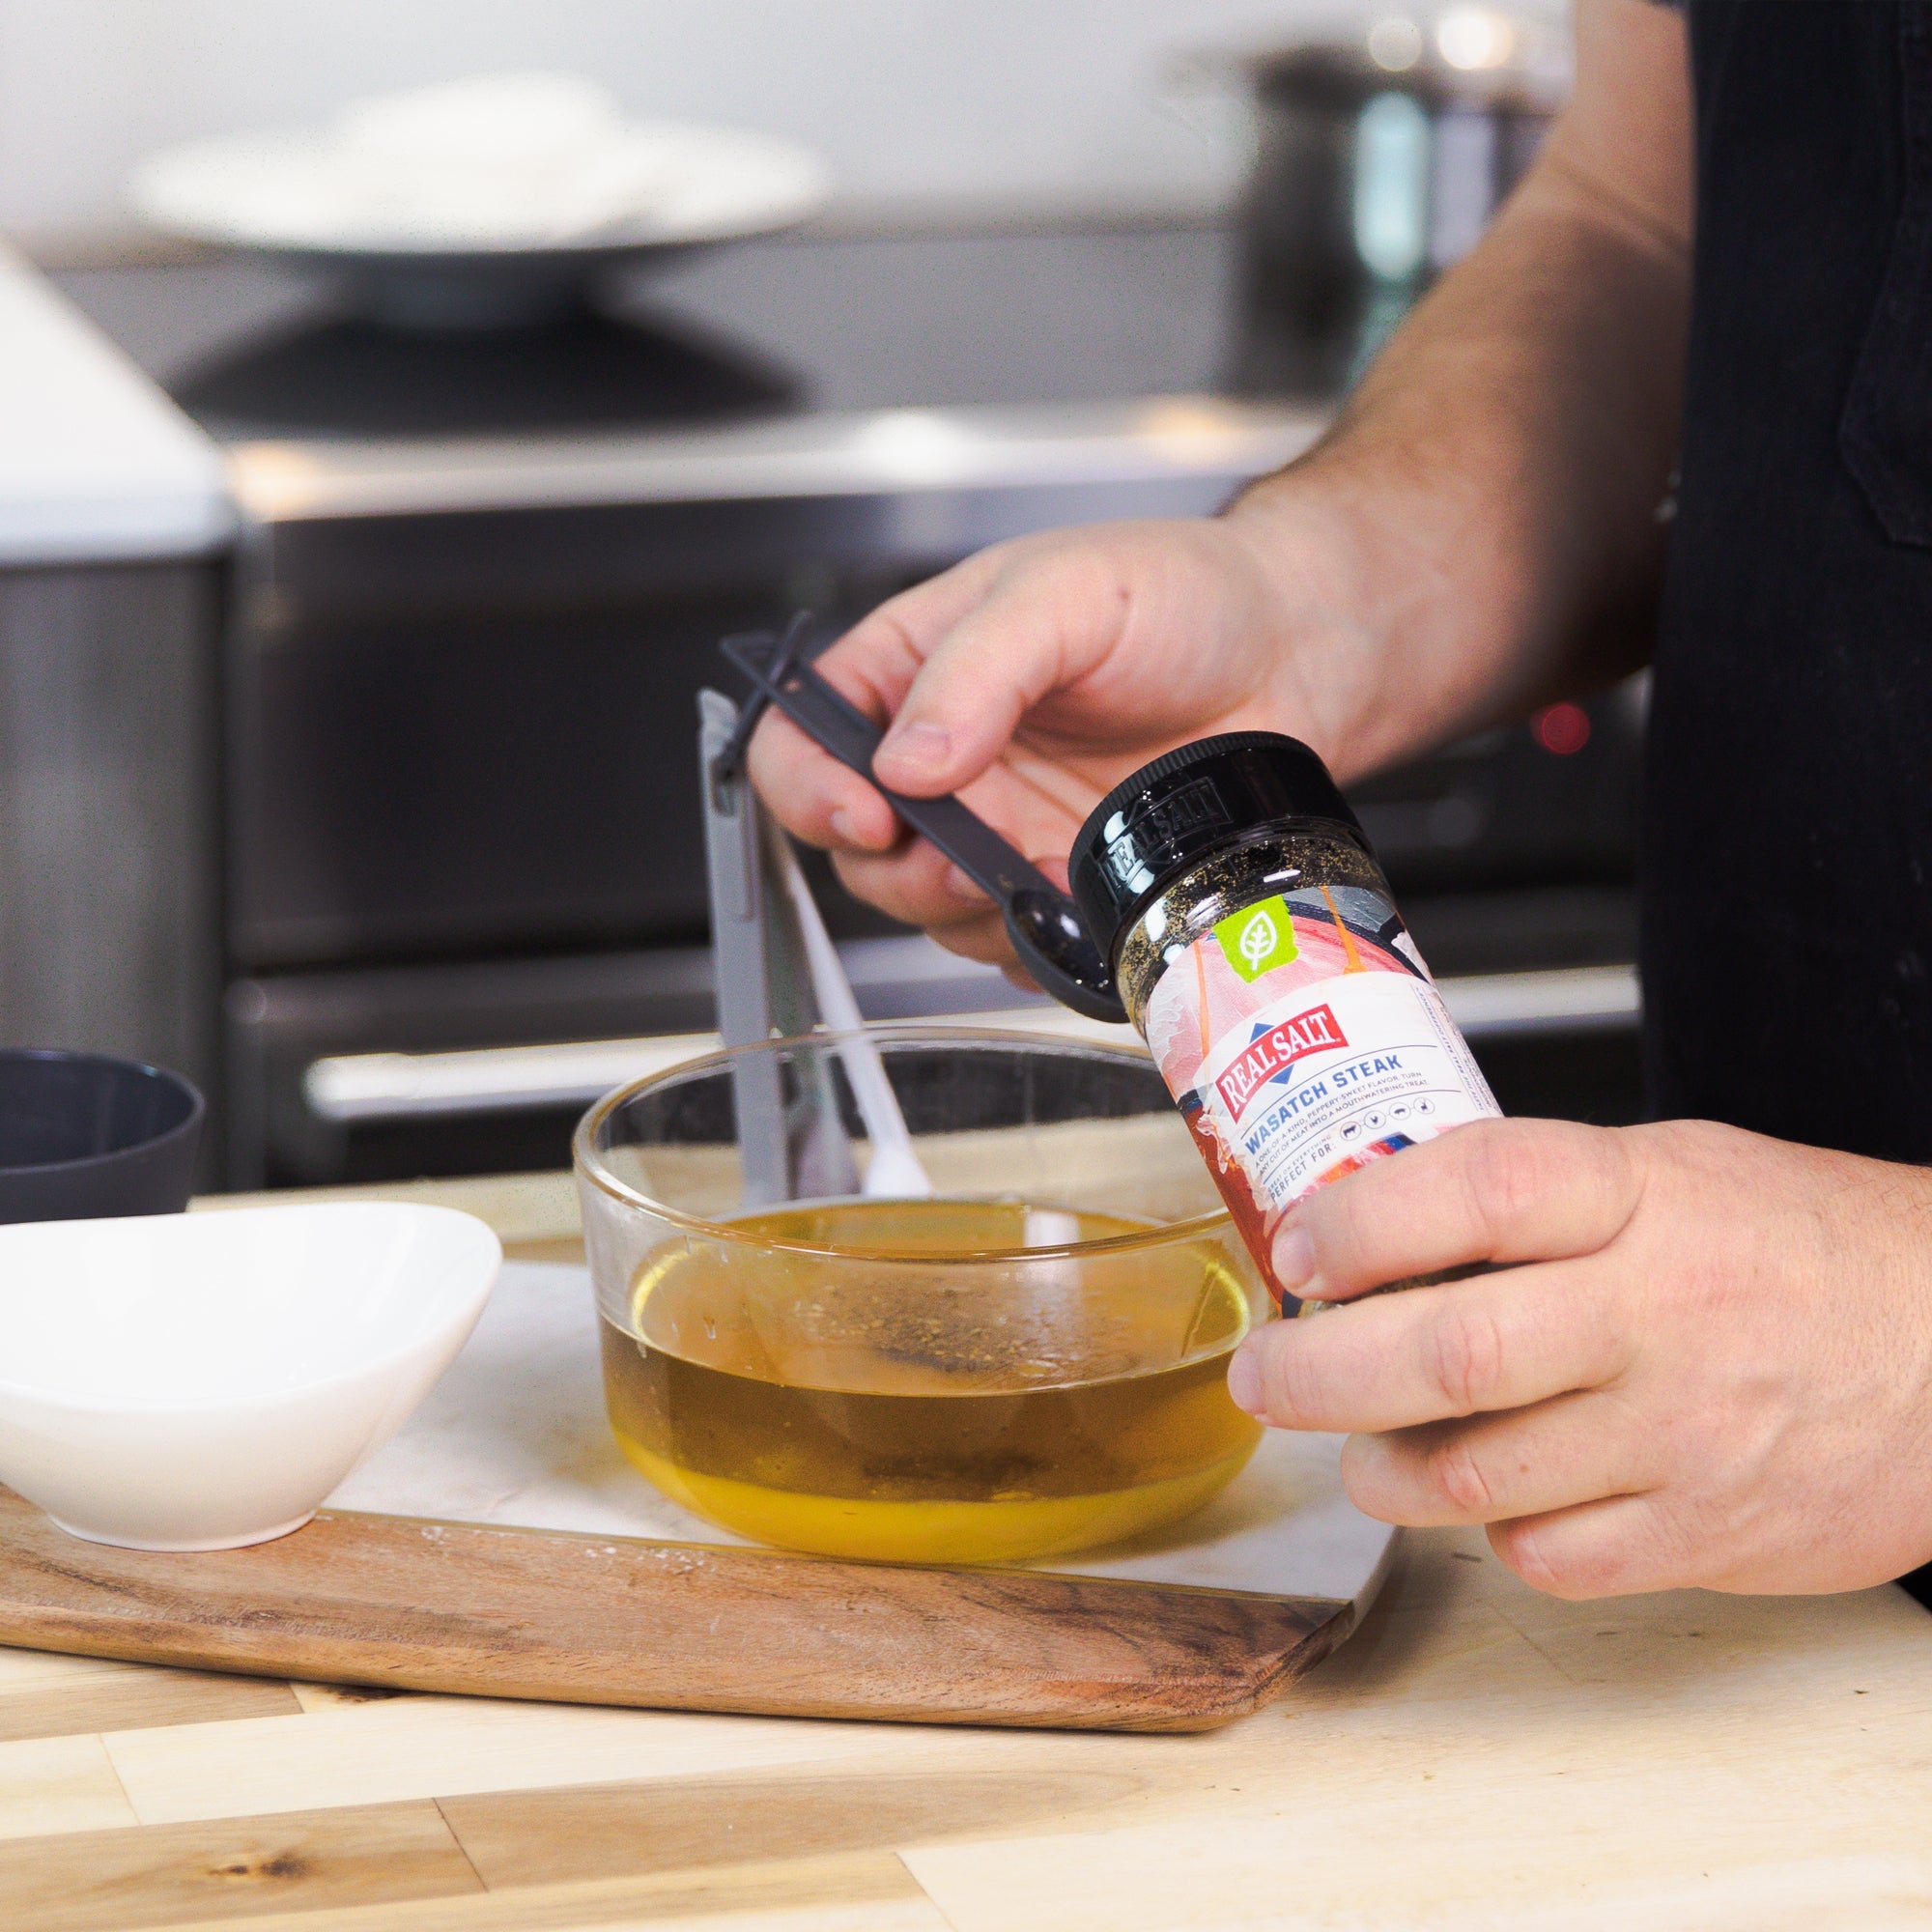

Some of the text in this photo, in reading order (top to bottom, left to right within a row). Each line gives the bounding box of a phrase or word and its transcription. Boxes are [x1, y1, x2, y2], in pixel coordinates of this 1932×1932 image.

[1152, 783, 1221, 839] SALT
[1221, 1010, 1336, 1113] REAL SALT
[1245, 1081, 1328, 1155] WASATCH
[1332, 1055, 1403, 1088] STEAK
[1260, 1161, 1270, 1176] ANY
[1270, 1150, 1281, 1163] CUT
[1281, 1142, 1290, 1151] OF
[1291, 1126, 1309, 1143] MEAT
[1310, 1114, 1327, 1128] INTO
[1335, 1083, 1405, 1112] MOUTHWATERING
[1270, 1160, 1307, 1203] PERFECT
[1293, 1134, 1331, 1166] EVERYTHING
